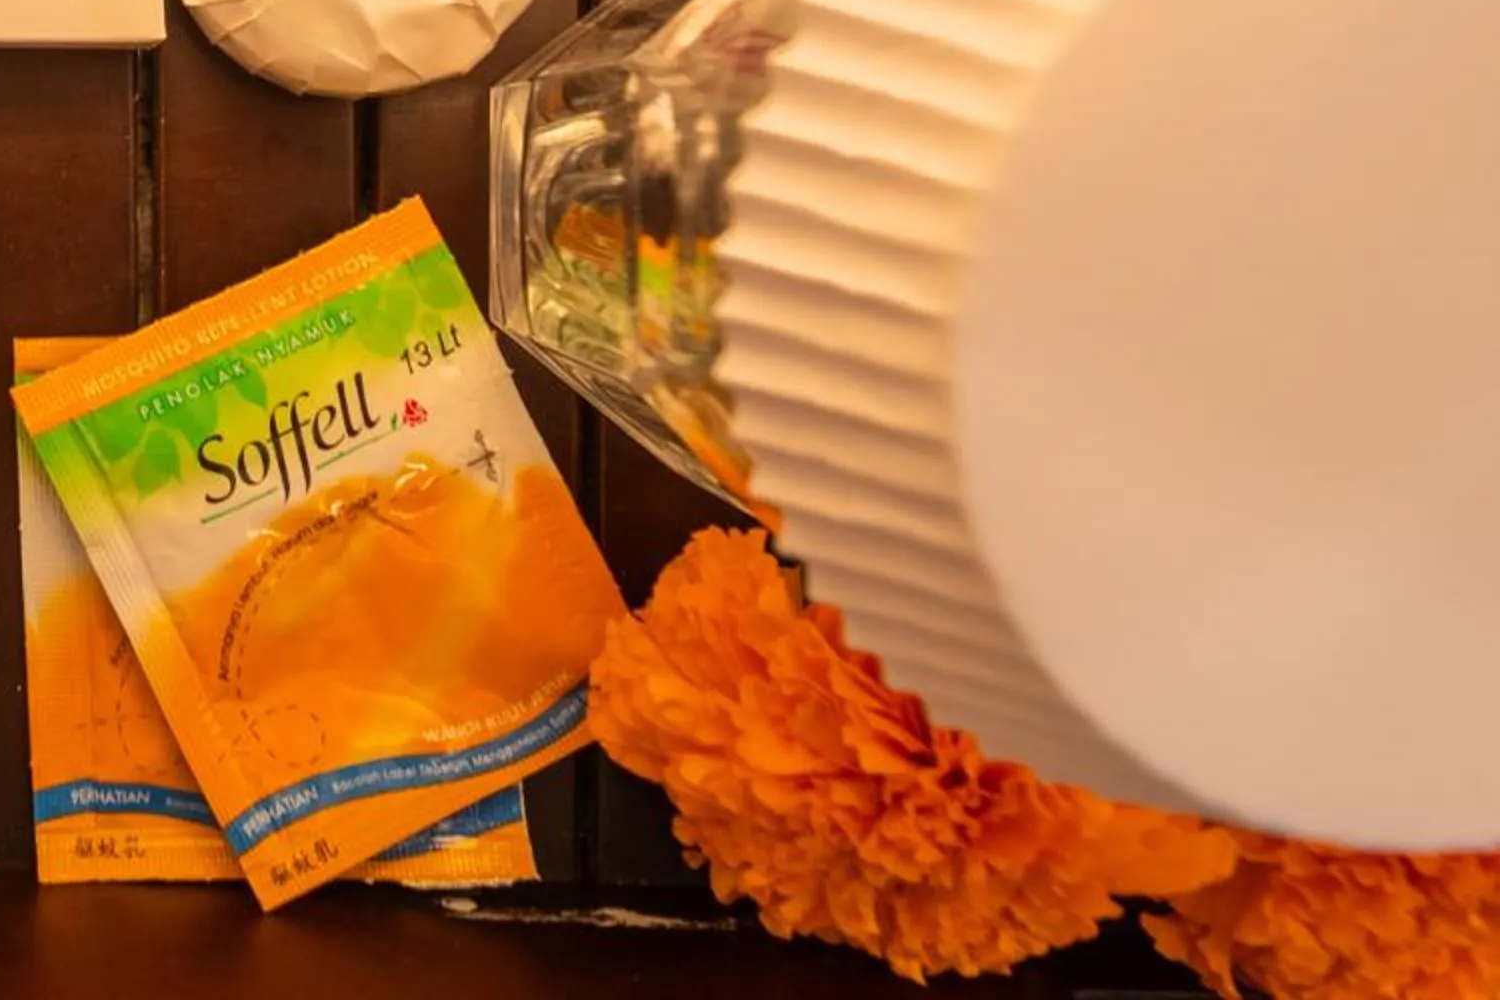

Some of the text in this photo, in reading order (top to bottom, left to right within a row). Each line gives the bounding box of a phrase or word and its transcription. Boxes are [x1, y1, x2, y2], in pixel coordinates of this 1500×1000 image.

[82, 339, 192, 401] MOSQUITO
[302, 250, 380, 296] LOTION
[139, 309, 356, 420] PENOLAK NYAMUK
[401, 341, 434, 375] 13
[197, 372, 381, 505] Soffell
